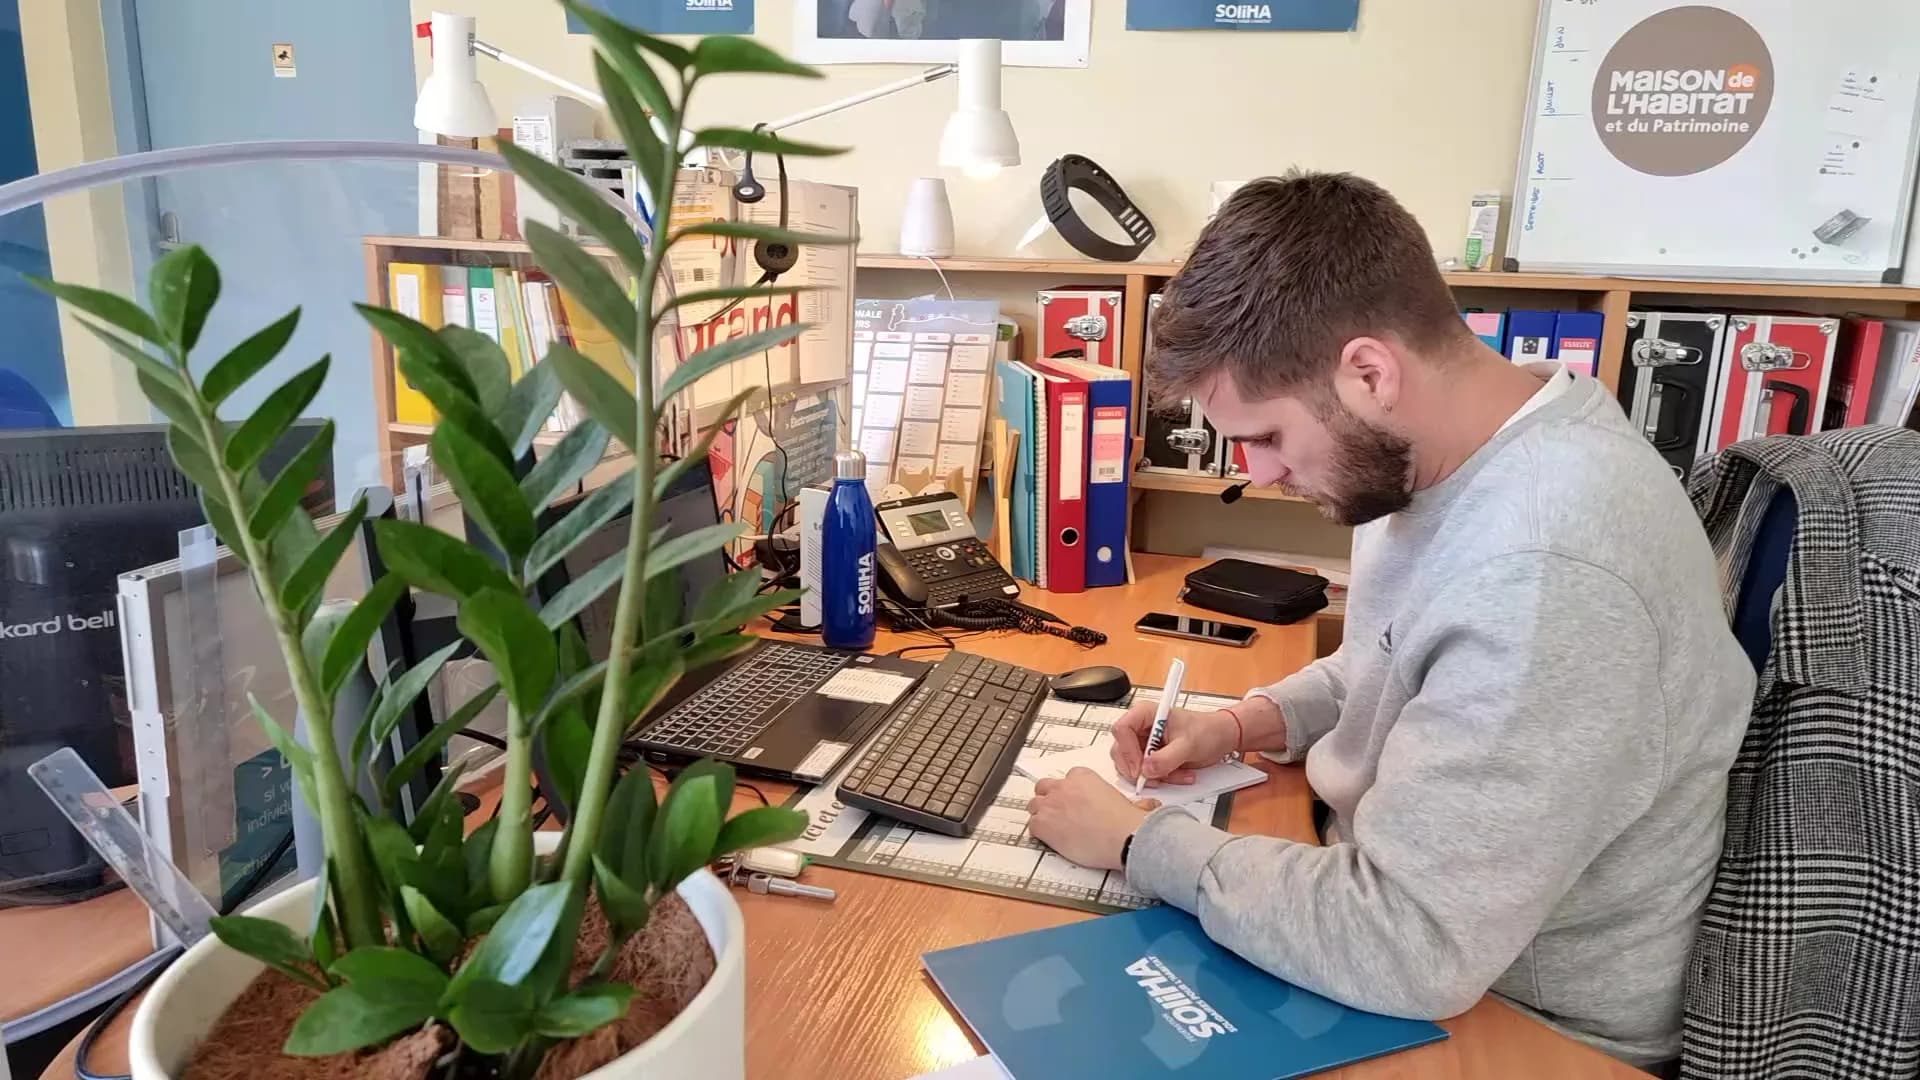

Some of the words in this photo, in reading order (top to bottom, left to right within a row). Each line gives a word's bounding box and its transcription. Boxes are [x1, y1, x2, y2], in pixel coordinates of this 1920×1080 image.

[1728, 71, 1755, 88] de
[1605, 118, 1623, 132] et
[1627, 118, 1649, 132] du
[1653, 118, 1750, 133] Patrimoine
[67, 610, 115, 631] bell
